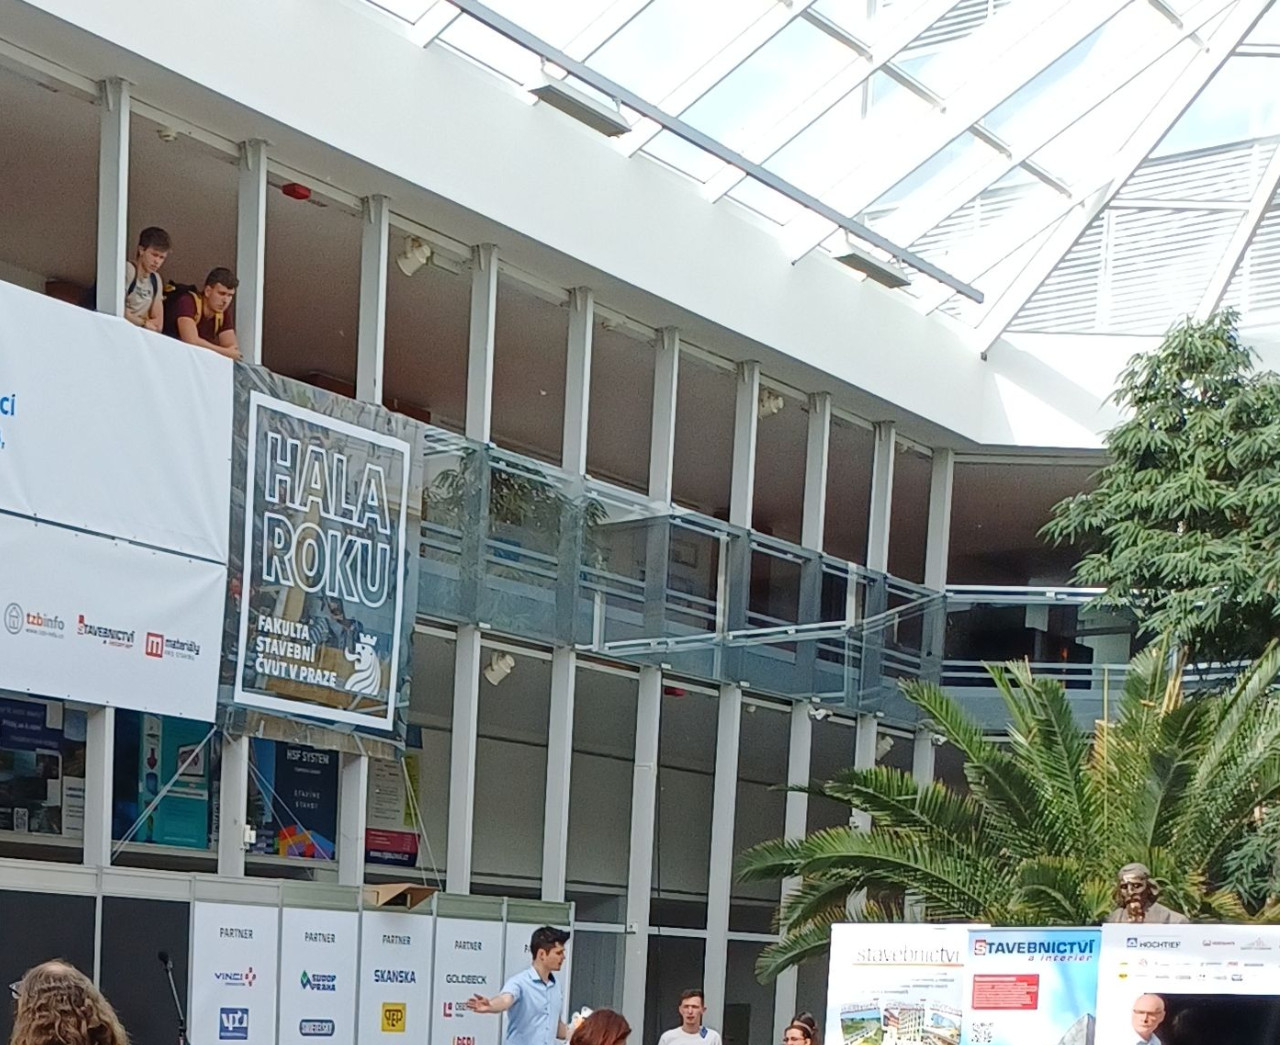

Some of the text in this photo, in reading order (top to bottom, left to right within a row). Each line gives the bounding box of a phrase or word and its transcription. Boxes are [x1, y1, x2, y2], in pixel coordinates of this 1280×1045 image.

[265, 431, 391, 535] HALA
[262, 511, 391, 608] ROKU
[257, 614, 311, 641] FAKULTA
[256, 635, 317, 663] STAVEBNÍ
[255, 654, 337, 687] ČVUT V PRAZE
[302, 751, 330, 765] SYSTEM
[219, 927, 253, 939] PARTNER
[304, 932, 336, 943] PARTNER
[382, 934, 411, 945] PARTNER
[454, 940, 482, 951] PARTNER
[974, 939, 1096, 956] STAVEBNICTVÍ
[214, 972, 243, 981] VINCI
[373, 969, 417, 983] SKANSKA
[446, 974, 487, 985] GOLDBECK
